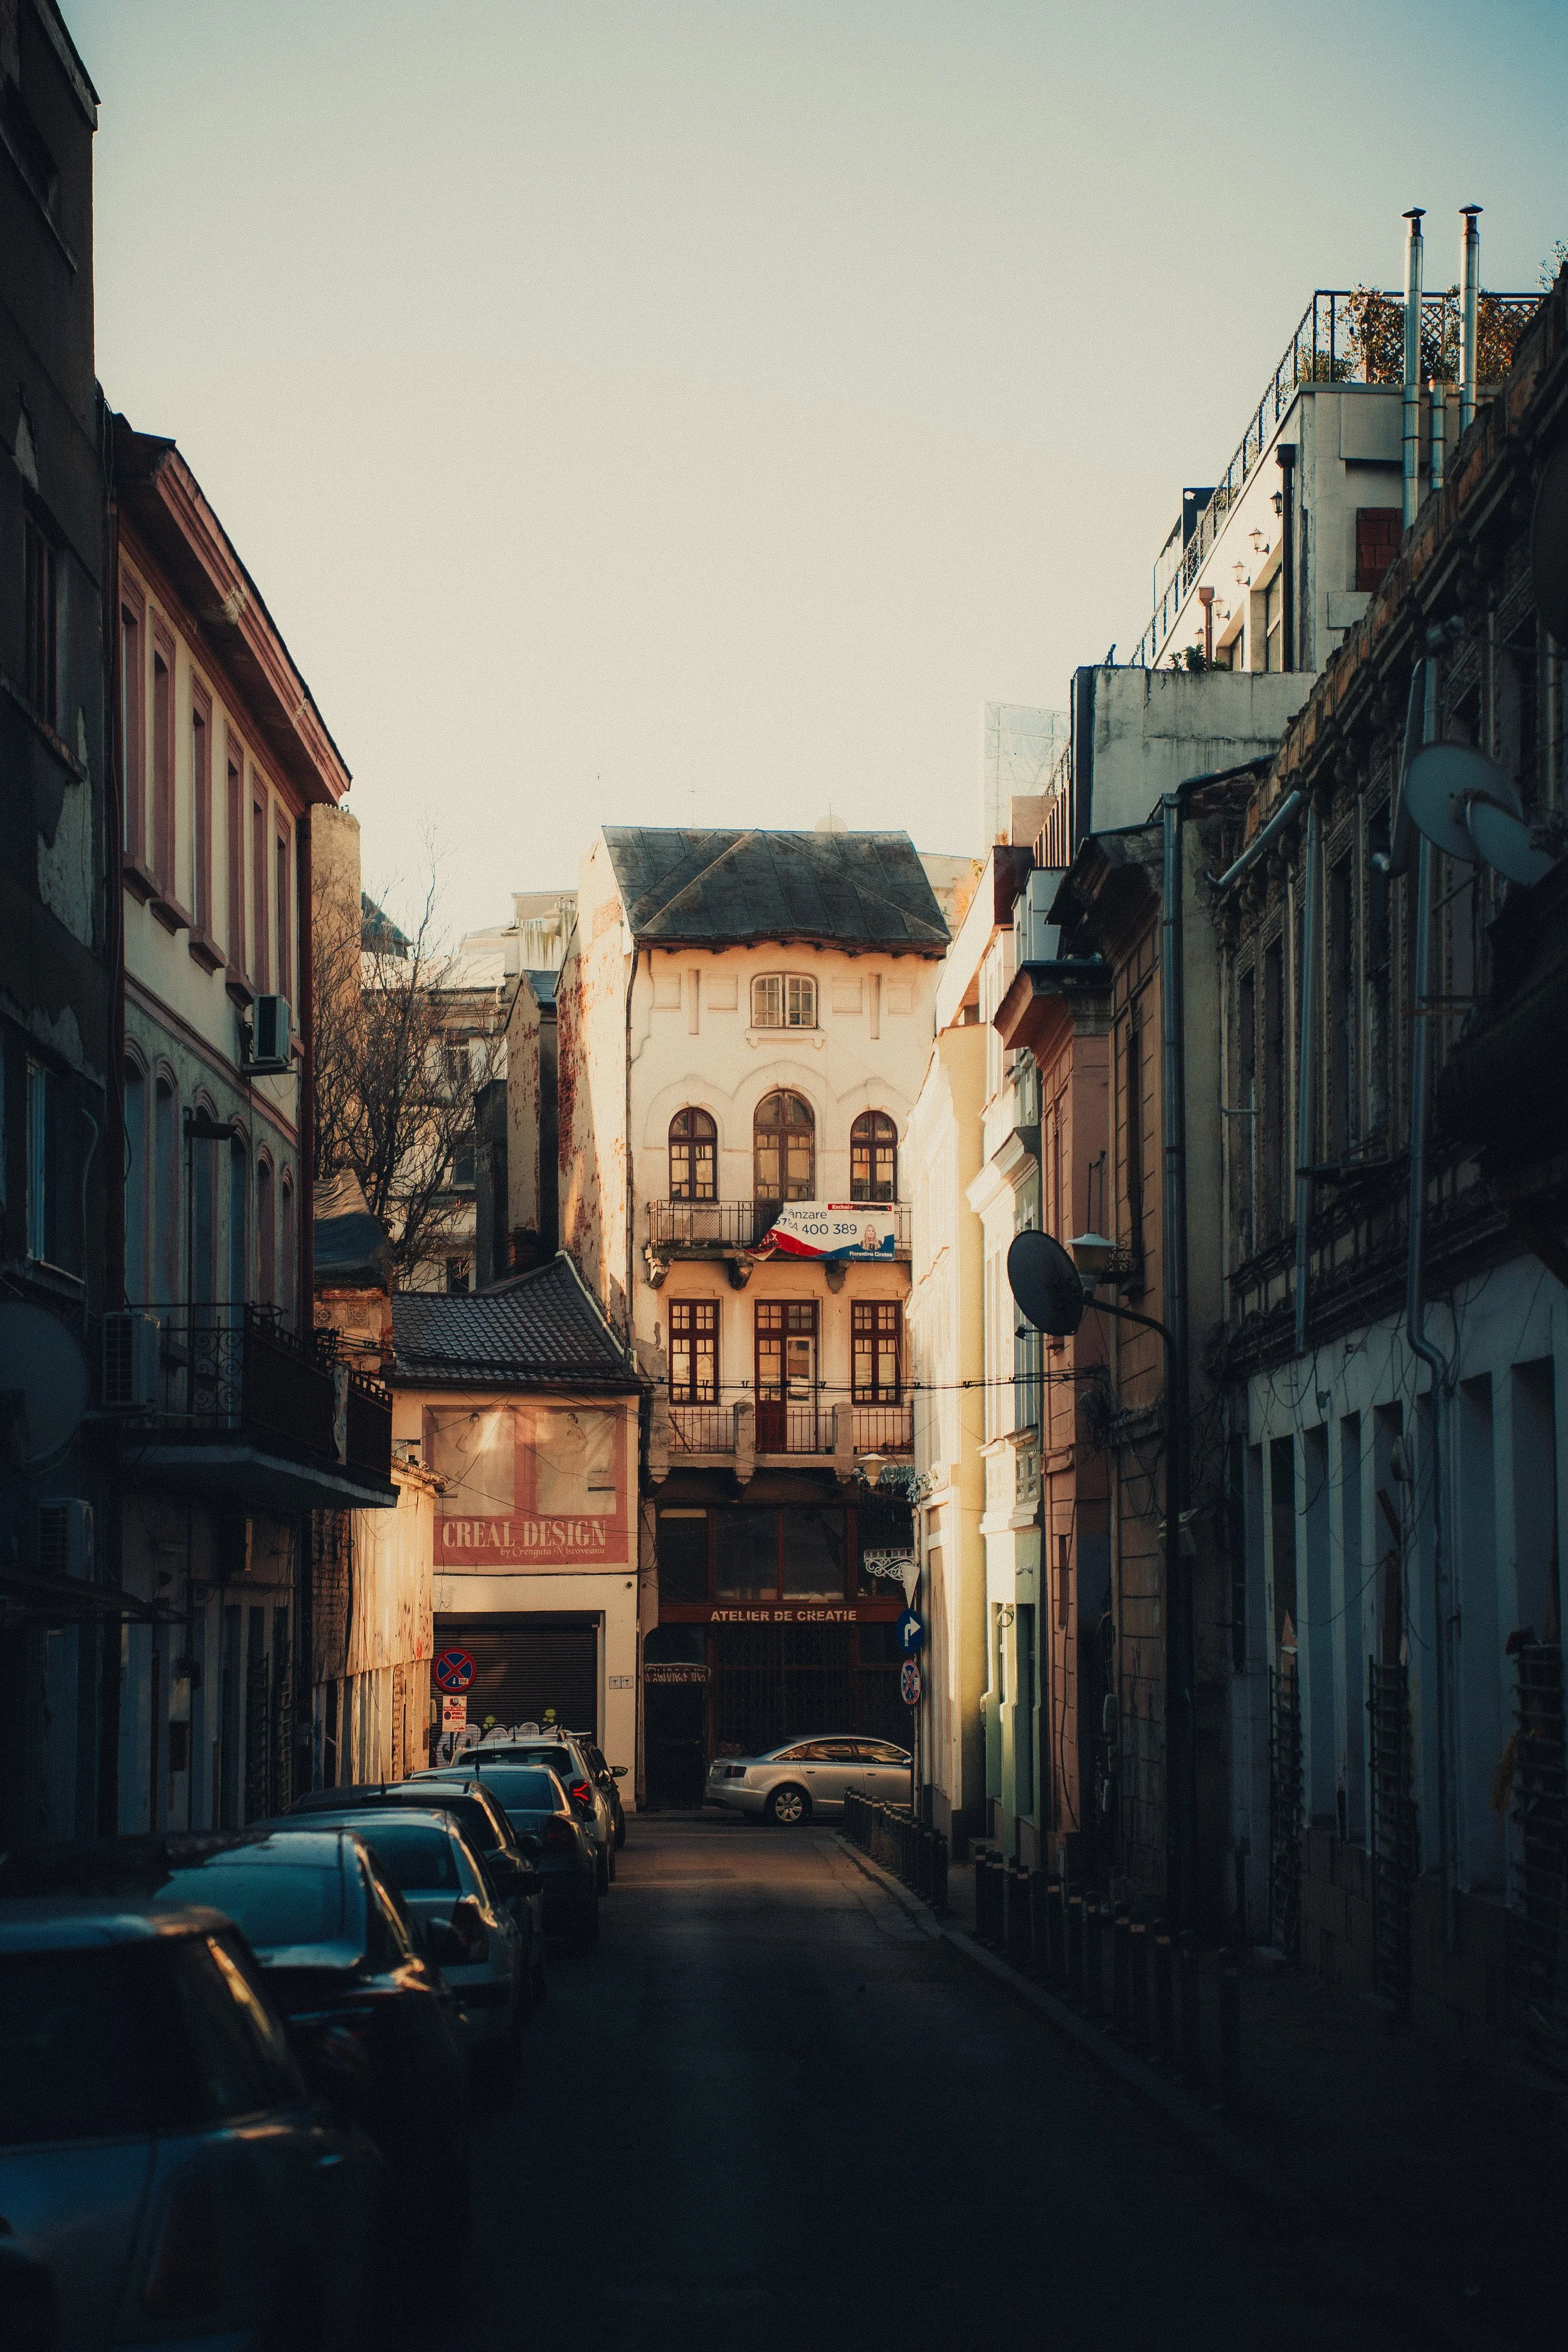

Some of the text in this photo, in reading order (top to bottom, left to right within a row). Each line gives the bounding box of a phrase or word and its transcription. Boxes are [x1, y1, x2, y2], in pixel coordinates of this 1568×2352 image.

[802, 1224, 829, 1235] 400
[833, 1224, 857, 1235] 389
[443, 1520, 607, 1548] CREAL DESIGN
[501, 1547, 511, 1559] by
[711, 1611, 770, 1621] ATELIER
[774, 1611, 793, 1621] DE
